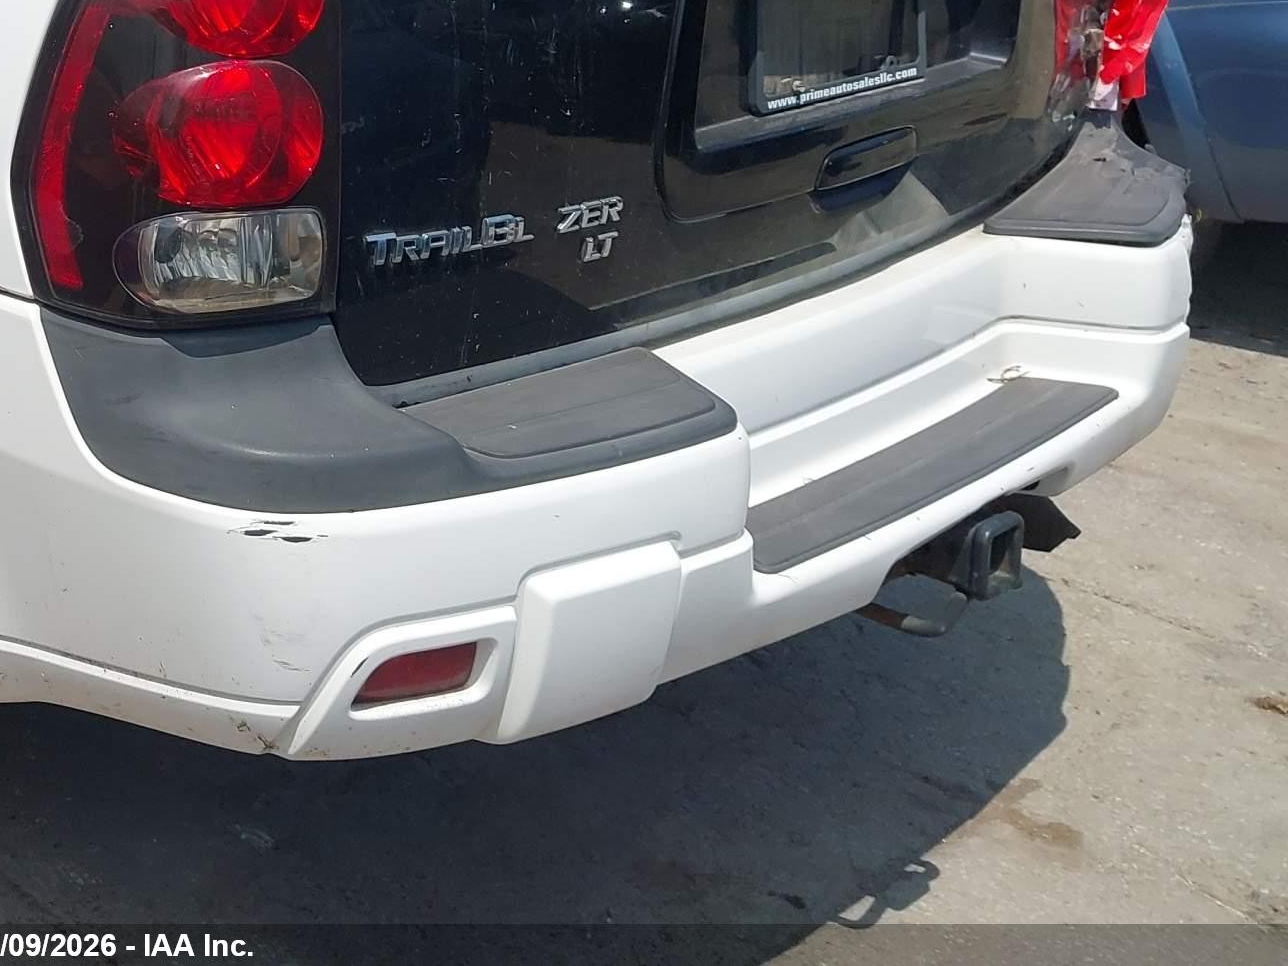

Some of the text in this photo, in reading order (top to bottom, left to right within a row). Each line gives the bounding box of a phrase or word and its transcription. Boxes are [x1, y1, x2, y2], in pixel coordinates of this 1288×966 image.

[767, 67, 918, 110] www.primeautosalesllc.com
[556, 195, 624, 234] ZER
[582, 230, 619, 263] LT
